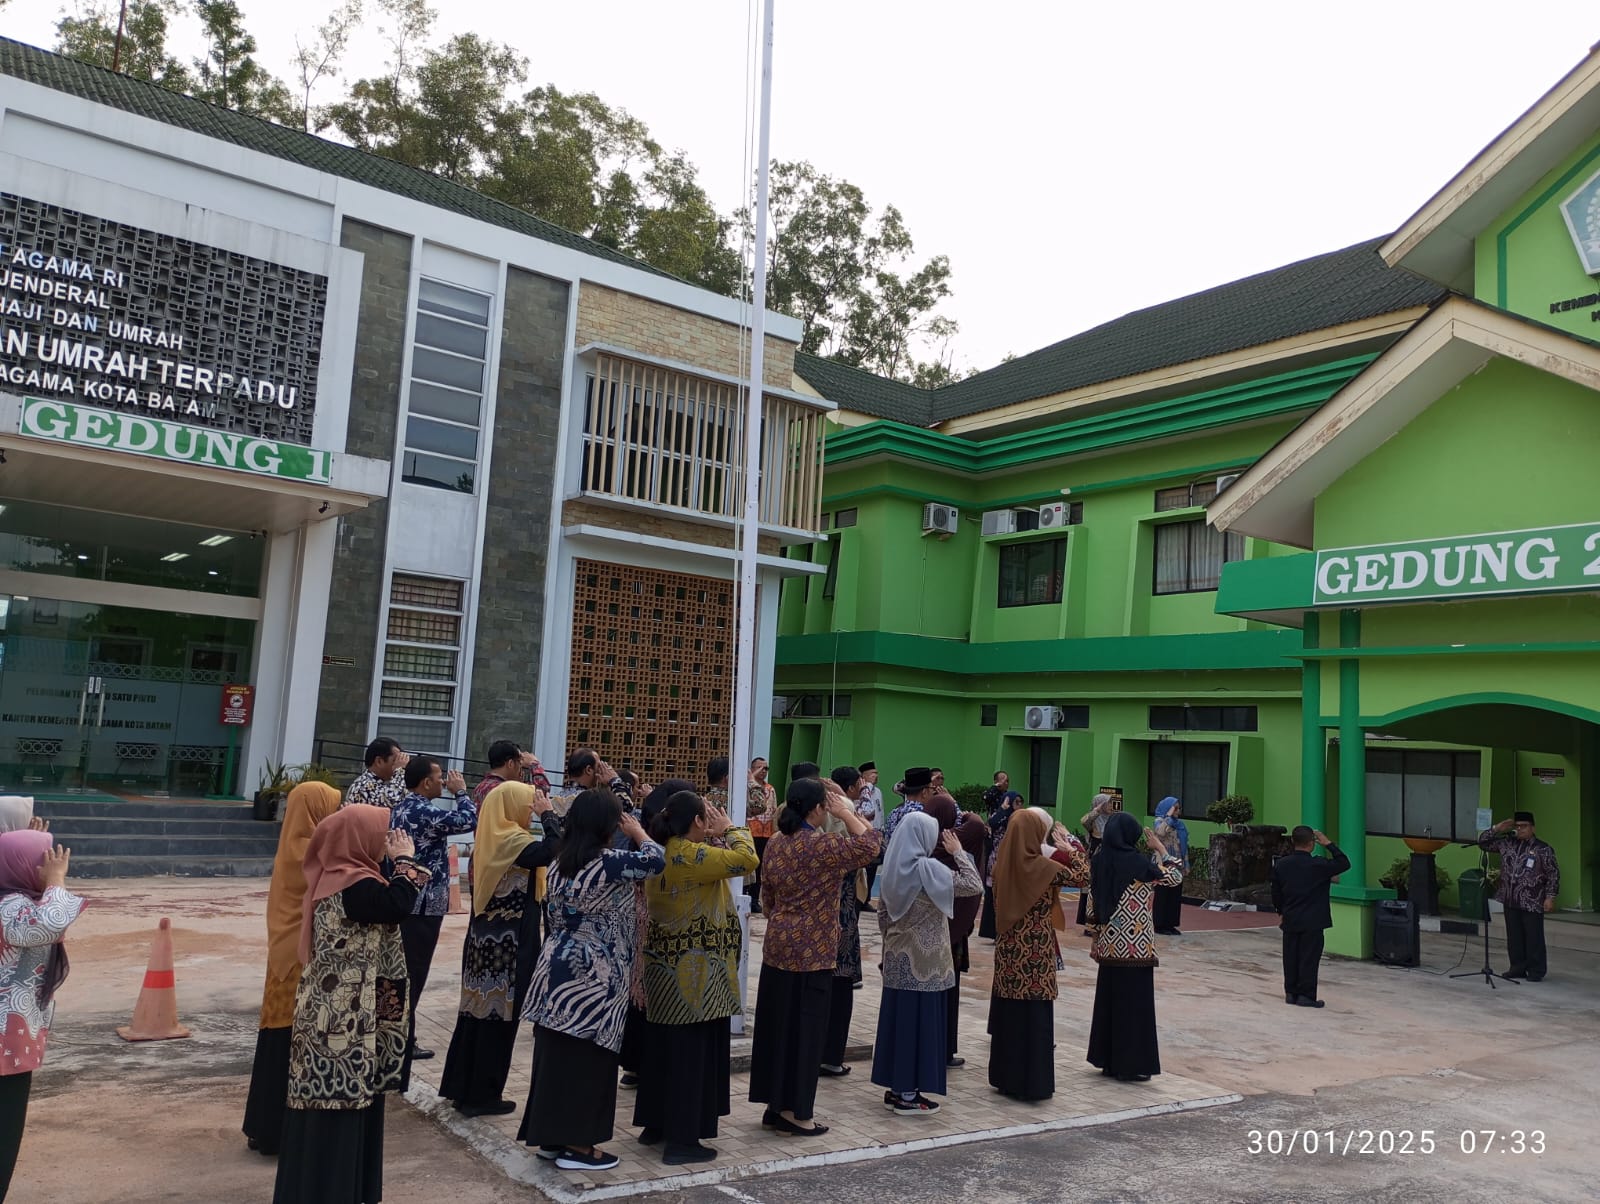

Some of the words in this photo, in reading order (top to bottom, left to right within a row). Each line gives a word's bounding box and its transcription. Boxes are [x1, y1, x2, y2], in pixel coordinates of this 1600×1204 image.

[12, 248, 93, 281] AGAMA
[102, 268, 123, 288] RI
[0, 269, 110, 310] JENDERAL
[1549, 292, 1600, 314] KEMEN
[53, 308, 98, 332] DAN
[108, 320, 183, 351] UMRAH
[0, 328, 28, 357] N
[37, 335, 149, 381] UMRAH
[156, 359, 296, 409] TERPADU
[0, 364, 74, 394] AGAMA
[84, 380, 138, 405] KOTA
[24, 401, 283, 474] GEDUNG
[305, 451, 329, 484] 1
[1317, 537, 1560, 594] GEDUNG
[1583, 532, 1600, 576] 2
